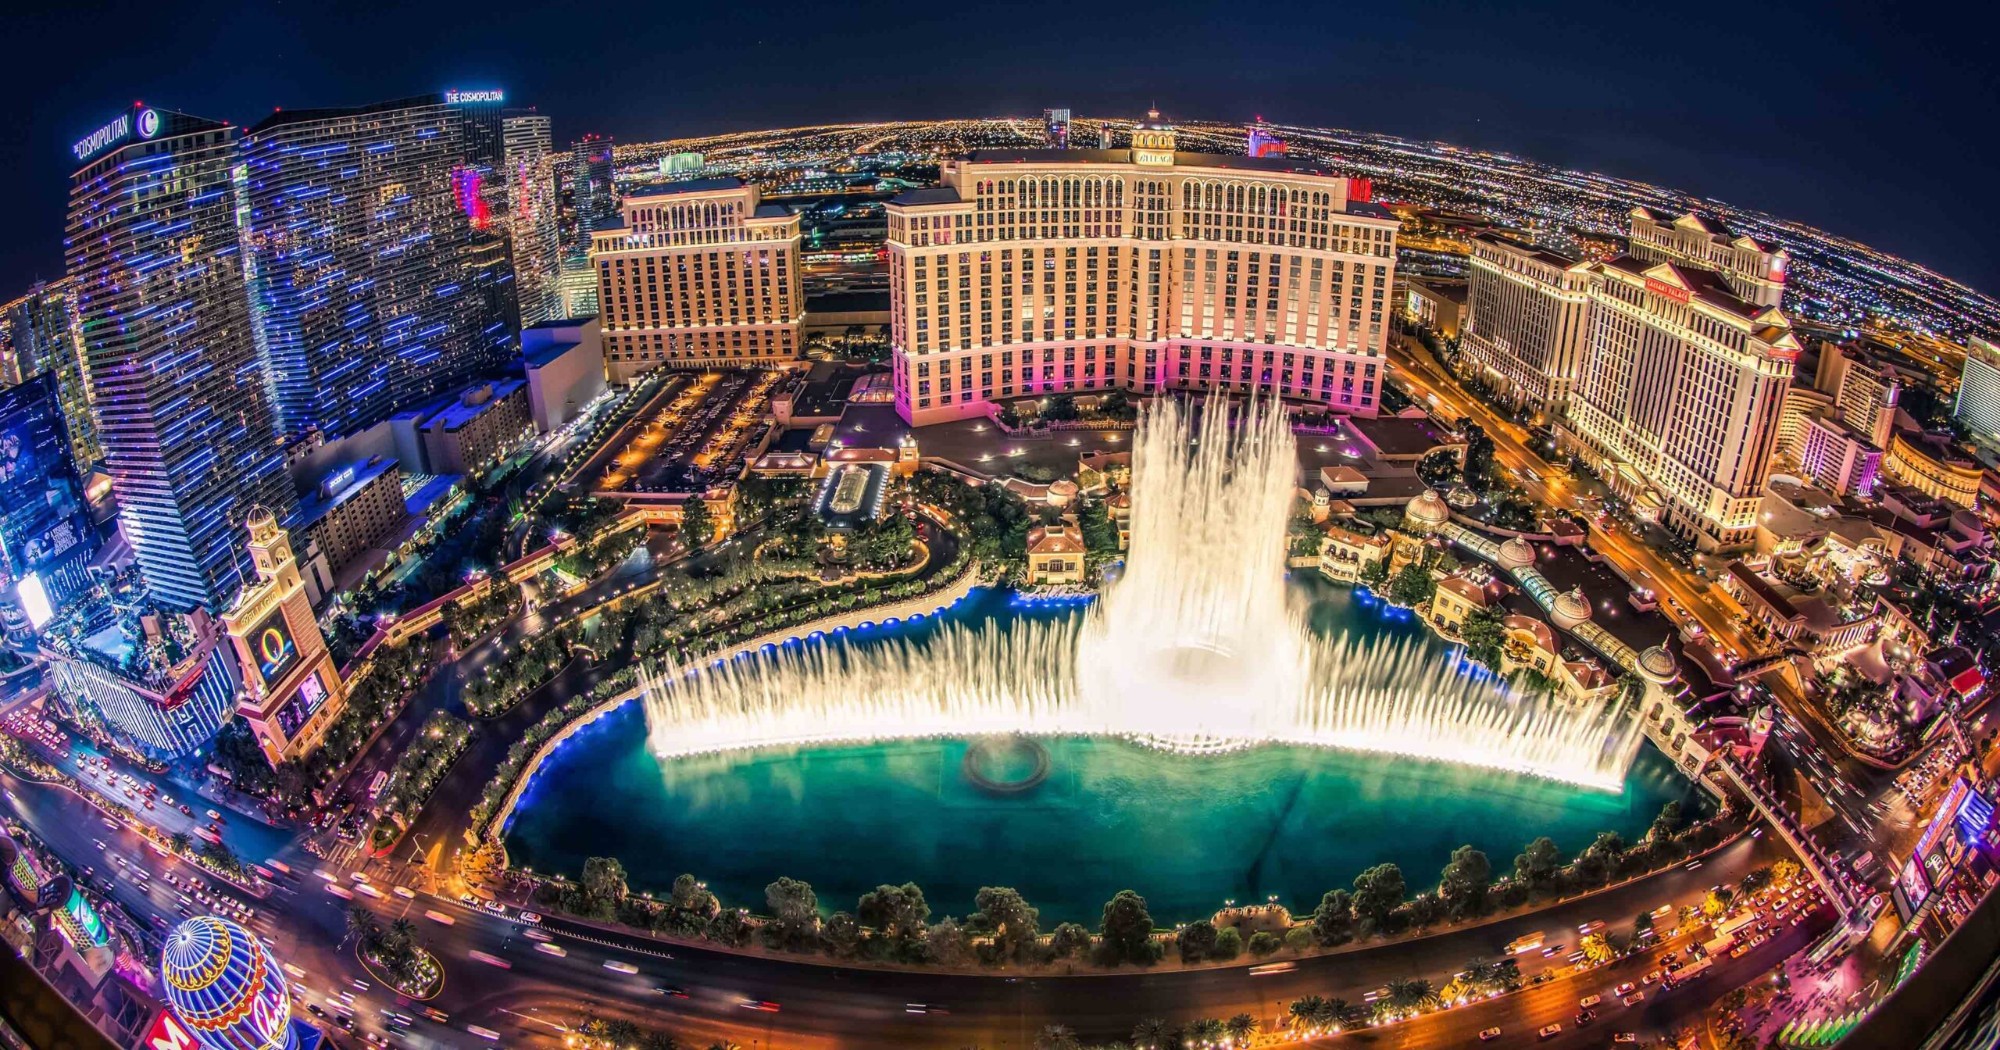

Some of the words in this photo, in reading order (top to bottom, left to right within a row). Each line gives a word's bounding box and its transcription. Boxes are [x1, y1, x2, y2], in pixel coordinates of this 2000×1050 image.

[447, 93, 459, 103] THE
[461, 91, 503, 102] COSMOPOLITAN
[79, 115, 128, 160] COSMOPOLITAN
[1647, 280, 1668, 294] CAESARS
[1668, 287, 1689, 302] PALACE
[241, 591, 279, 625] BELLAGIO
